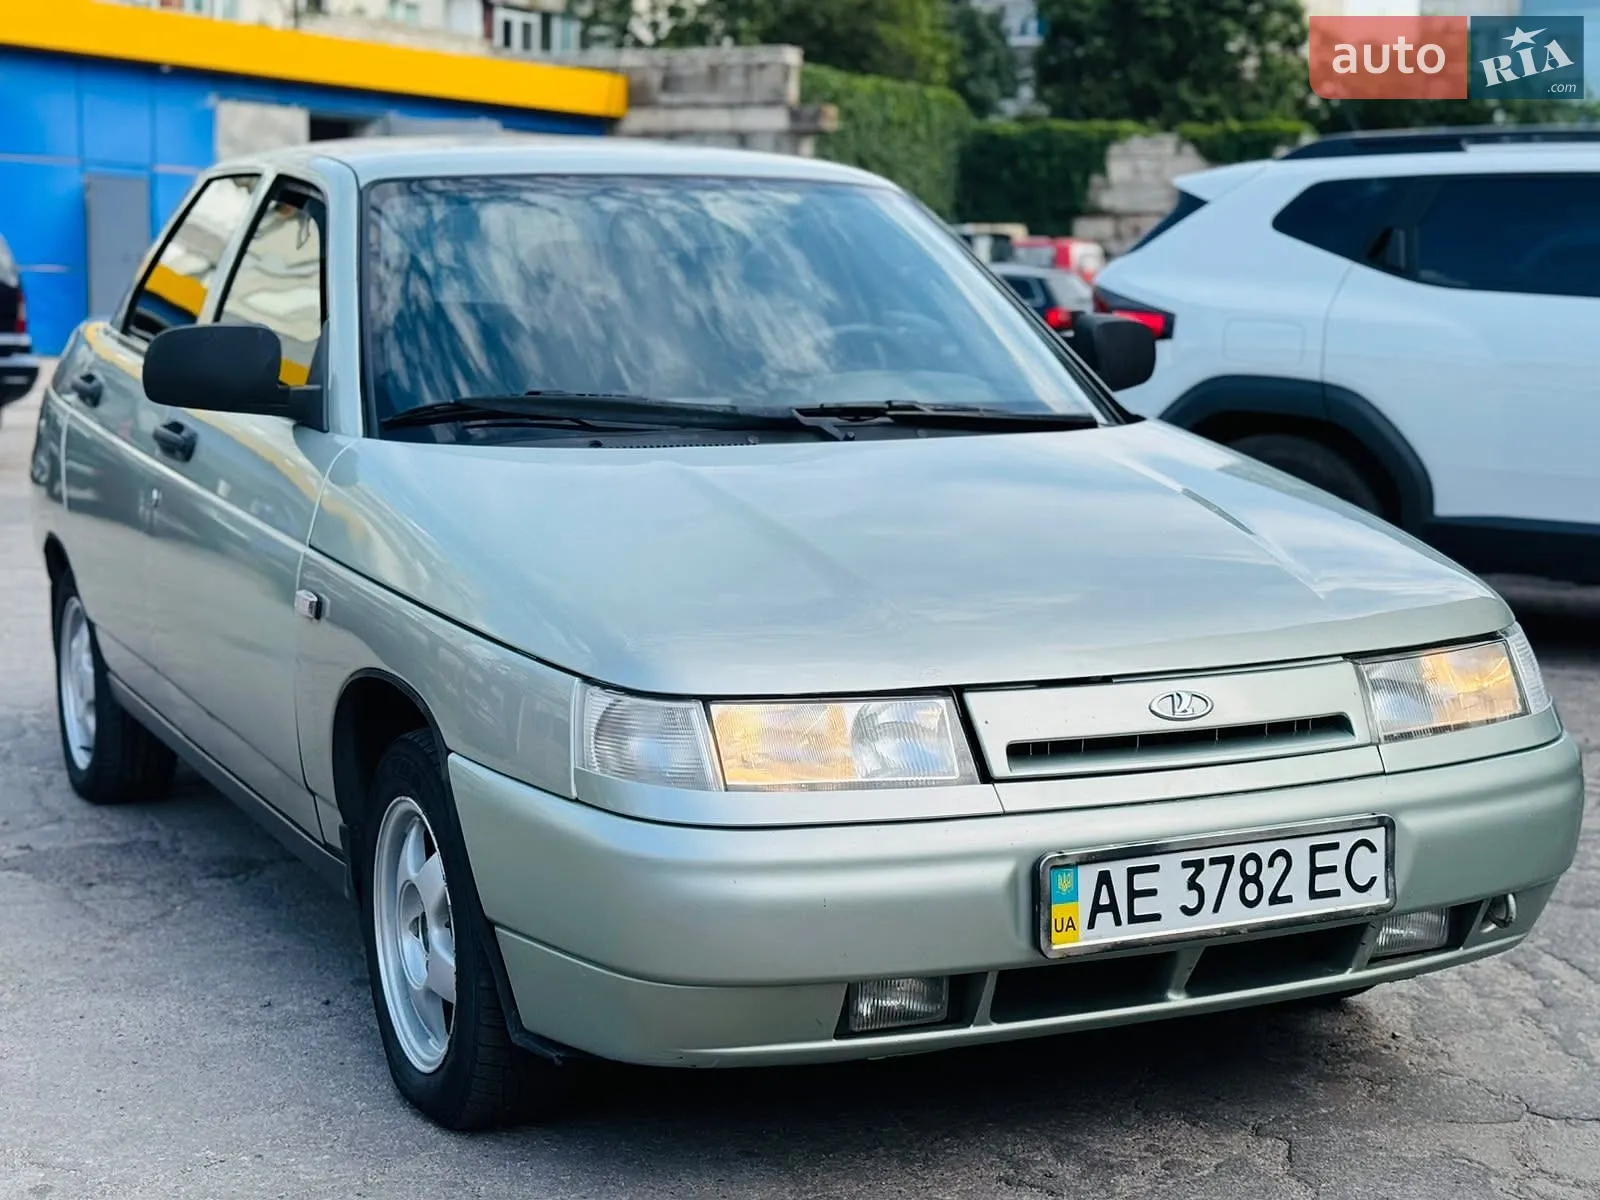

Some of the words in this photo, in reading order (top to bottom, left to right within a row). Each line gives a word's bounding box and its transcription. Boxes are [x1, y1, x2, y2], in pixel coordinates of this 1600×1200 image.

[1087, 863, 1162, 930] AE
[1179, 848, 1293, 917] 3782
[1308, 838, 1377, 901] EC
[1054, 915, 1077, 934] UA
